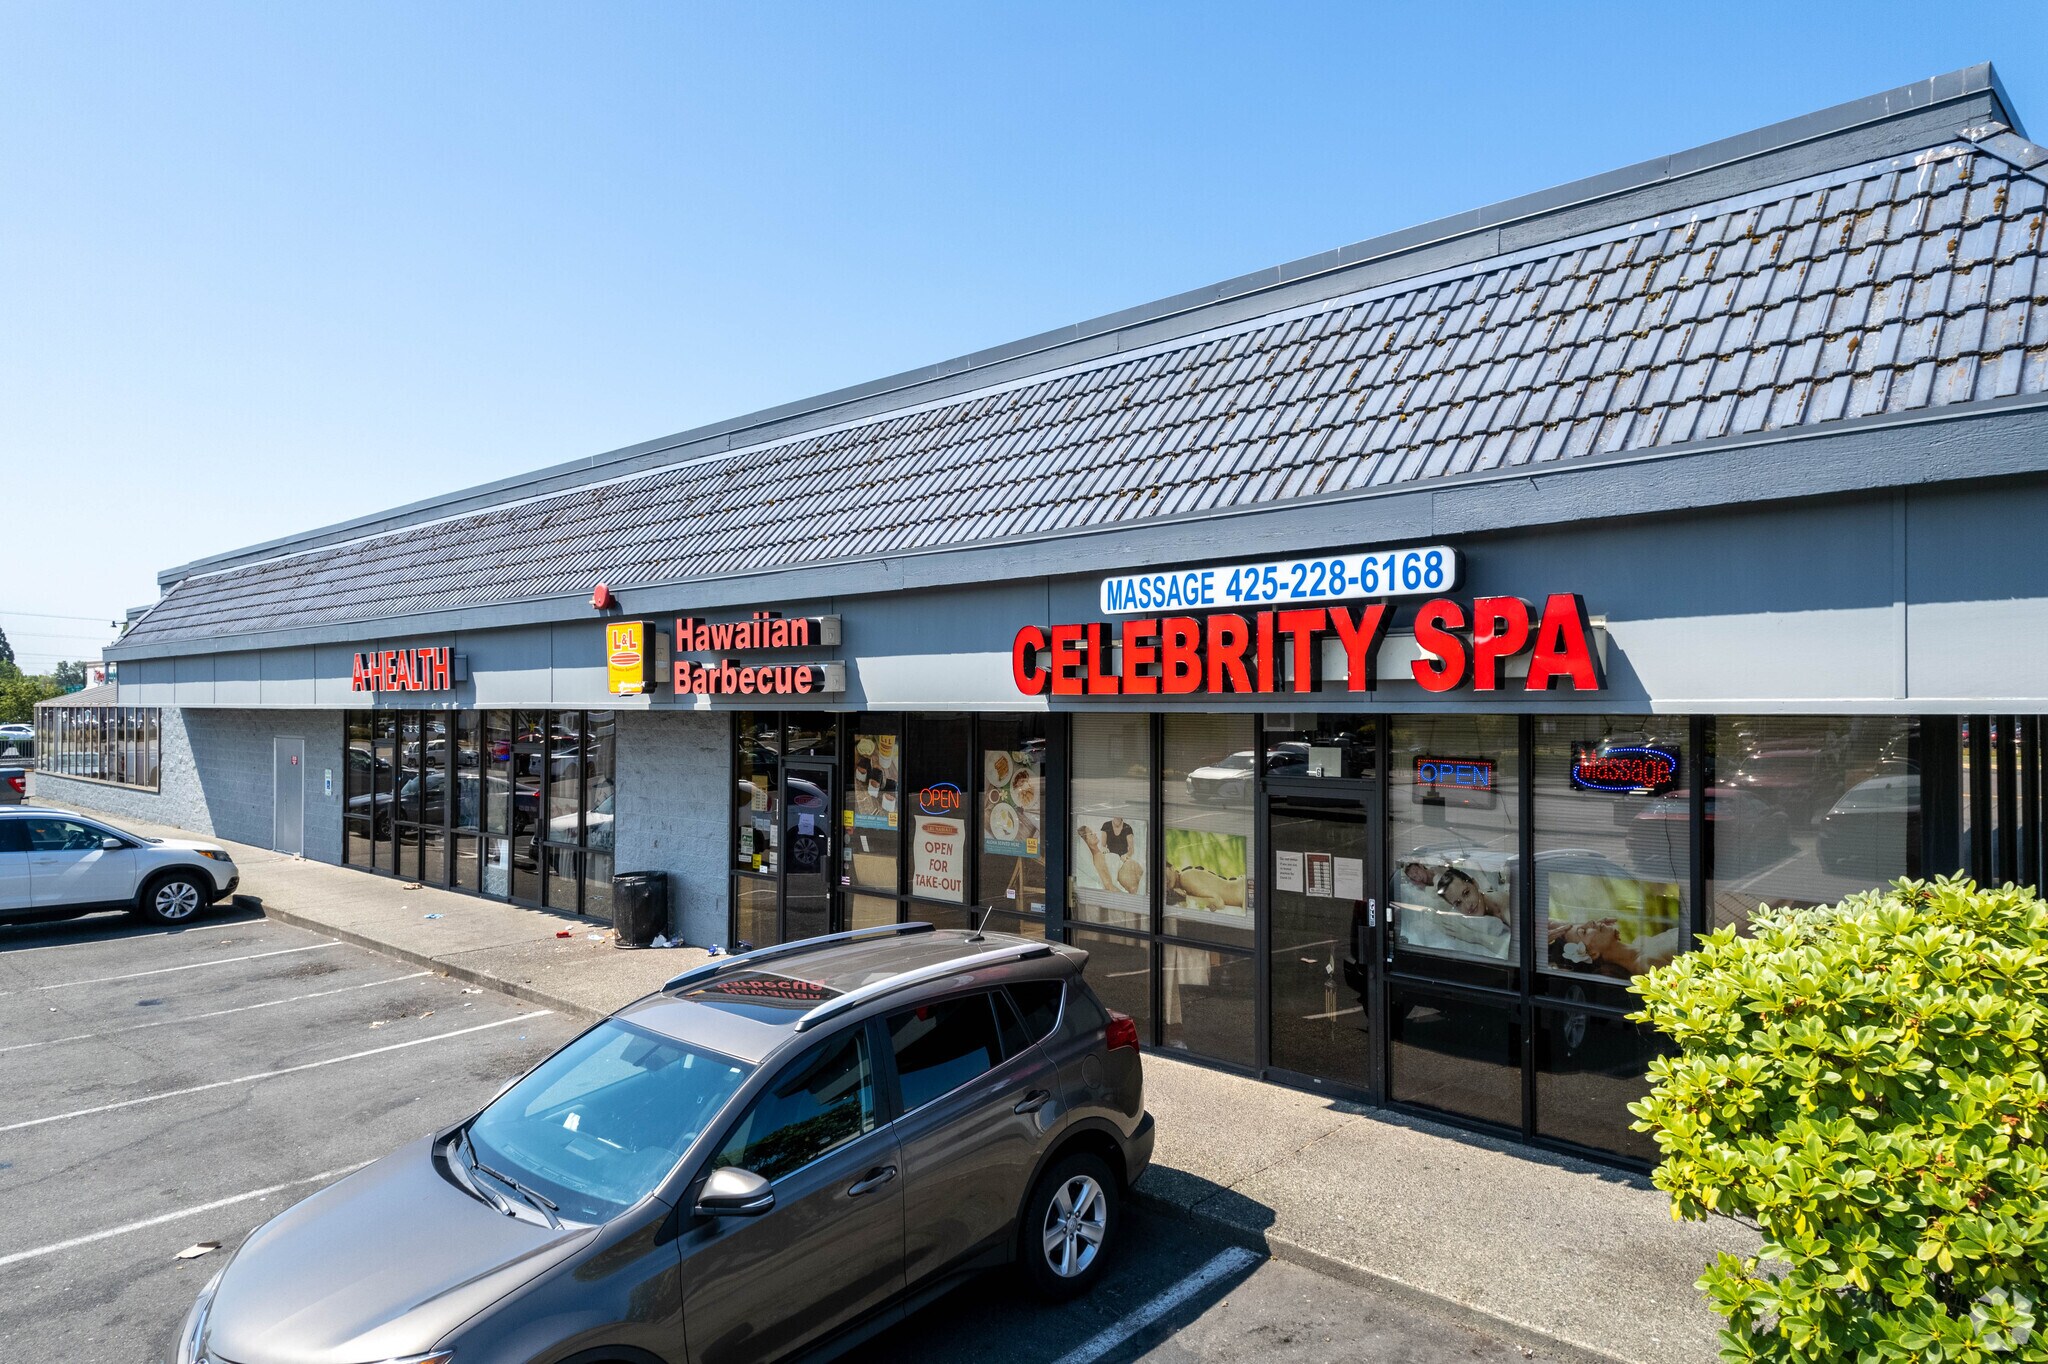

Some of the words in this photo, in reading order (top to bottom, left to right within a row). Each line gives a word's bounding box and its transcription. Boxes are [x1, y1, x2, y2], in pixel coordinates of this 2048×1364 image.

[1106, 571, 1215, 611] MASSAGE
[1226, 550, 1444, 604] 425-228-6168
[612, 628, 638, 650] L&L
[675, 611, 809, 652] Hawaiian
[1012, 603, 1387, 696] CELEBRITY
[1410, 592, 1600, 692] SPA
[351, 646, 451, 692] A-HEALTH
[674, 658, 813, 695] Barbecue
[1420, 763, 1489, 786] OPEN
[1579, 748, 1670, 788] Massage
[919, 787, 960, 809] OPEN
[924, 841, 953, 856] OPEN
[929, 859, 948, 872] FOR
[915, 874, 962, 892] TAKE-OUT
